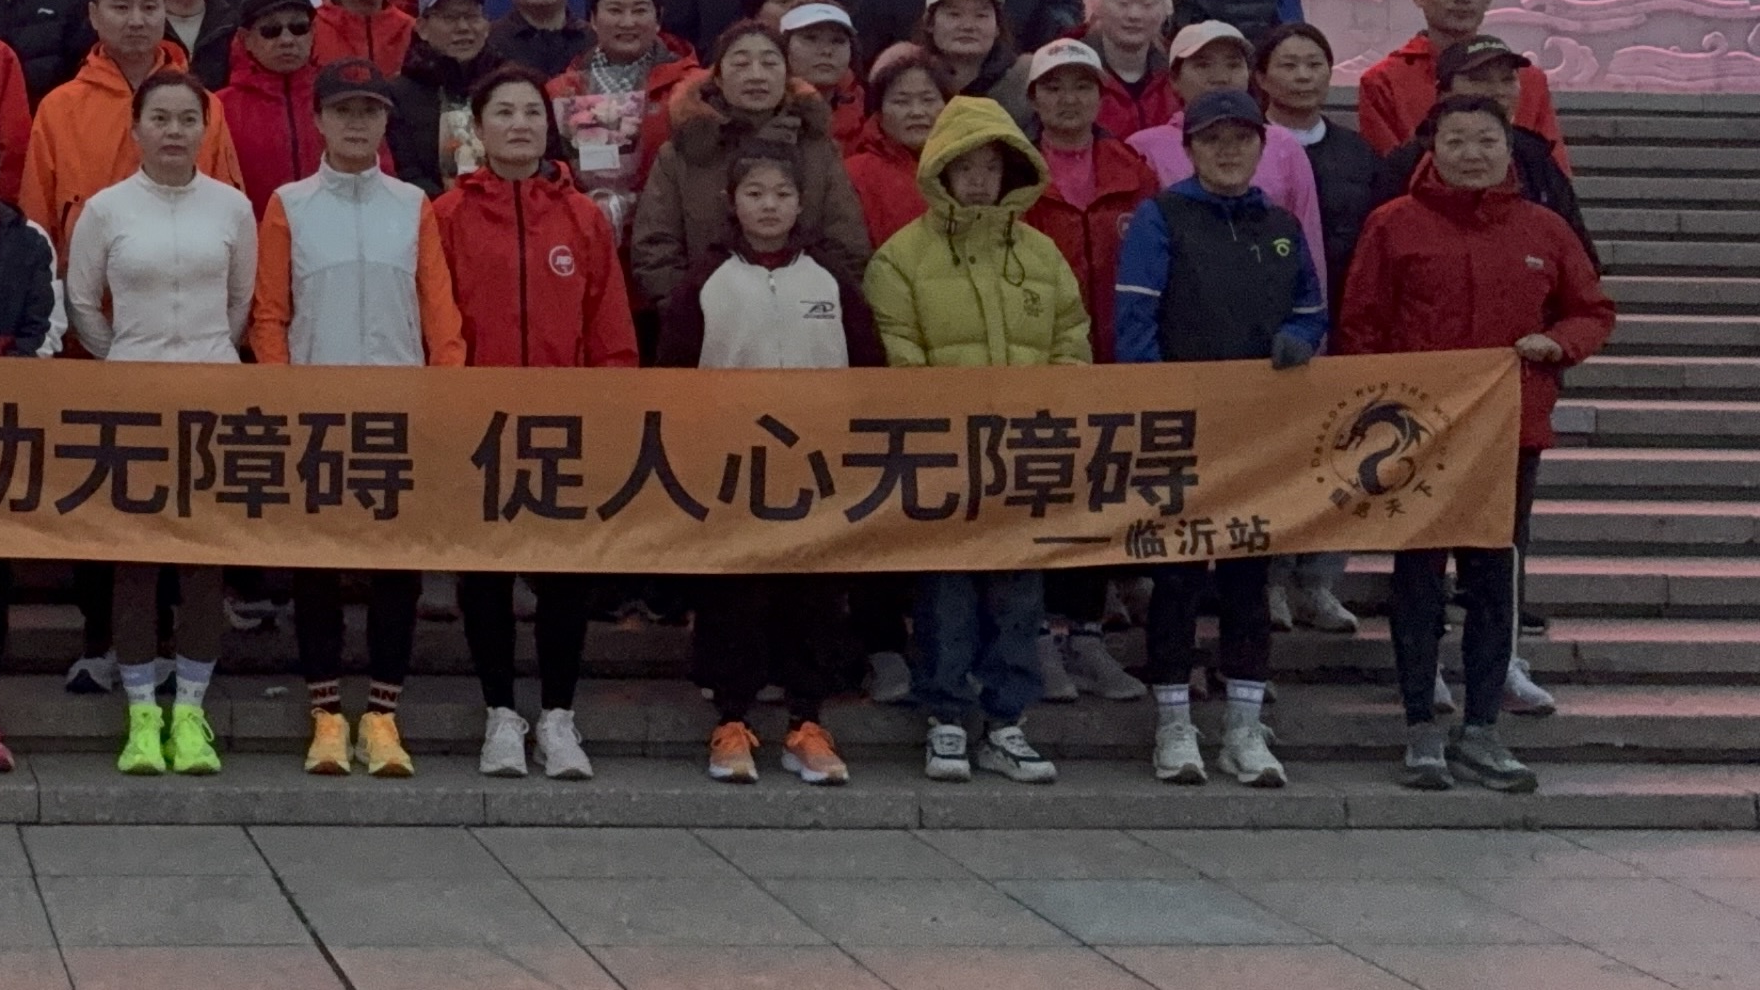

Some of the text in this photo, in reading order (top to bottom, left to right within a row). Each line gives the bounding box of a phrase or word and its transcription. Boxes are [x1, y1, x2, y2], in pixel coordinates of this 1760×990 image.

[471, 409, 1200, 524] 促人心无障碍
